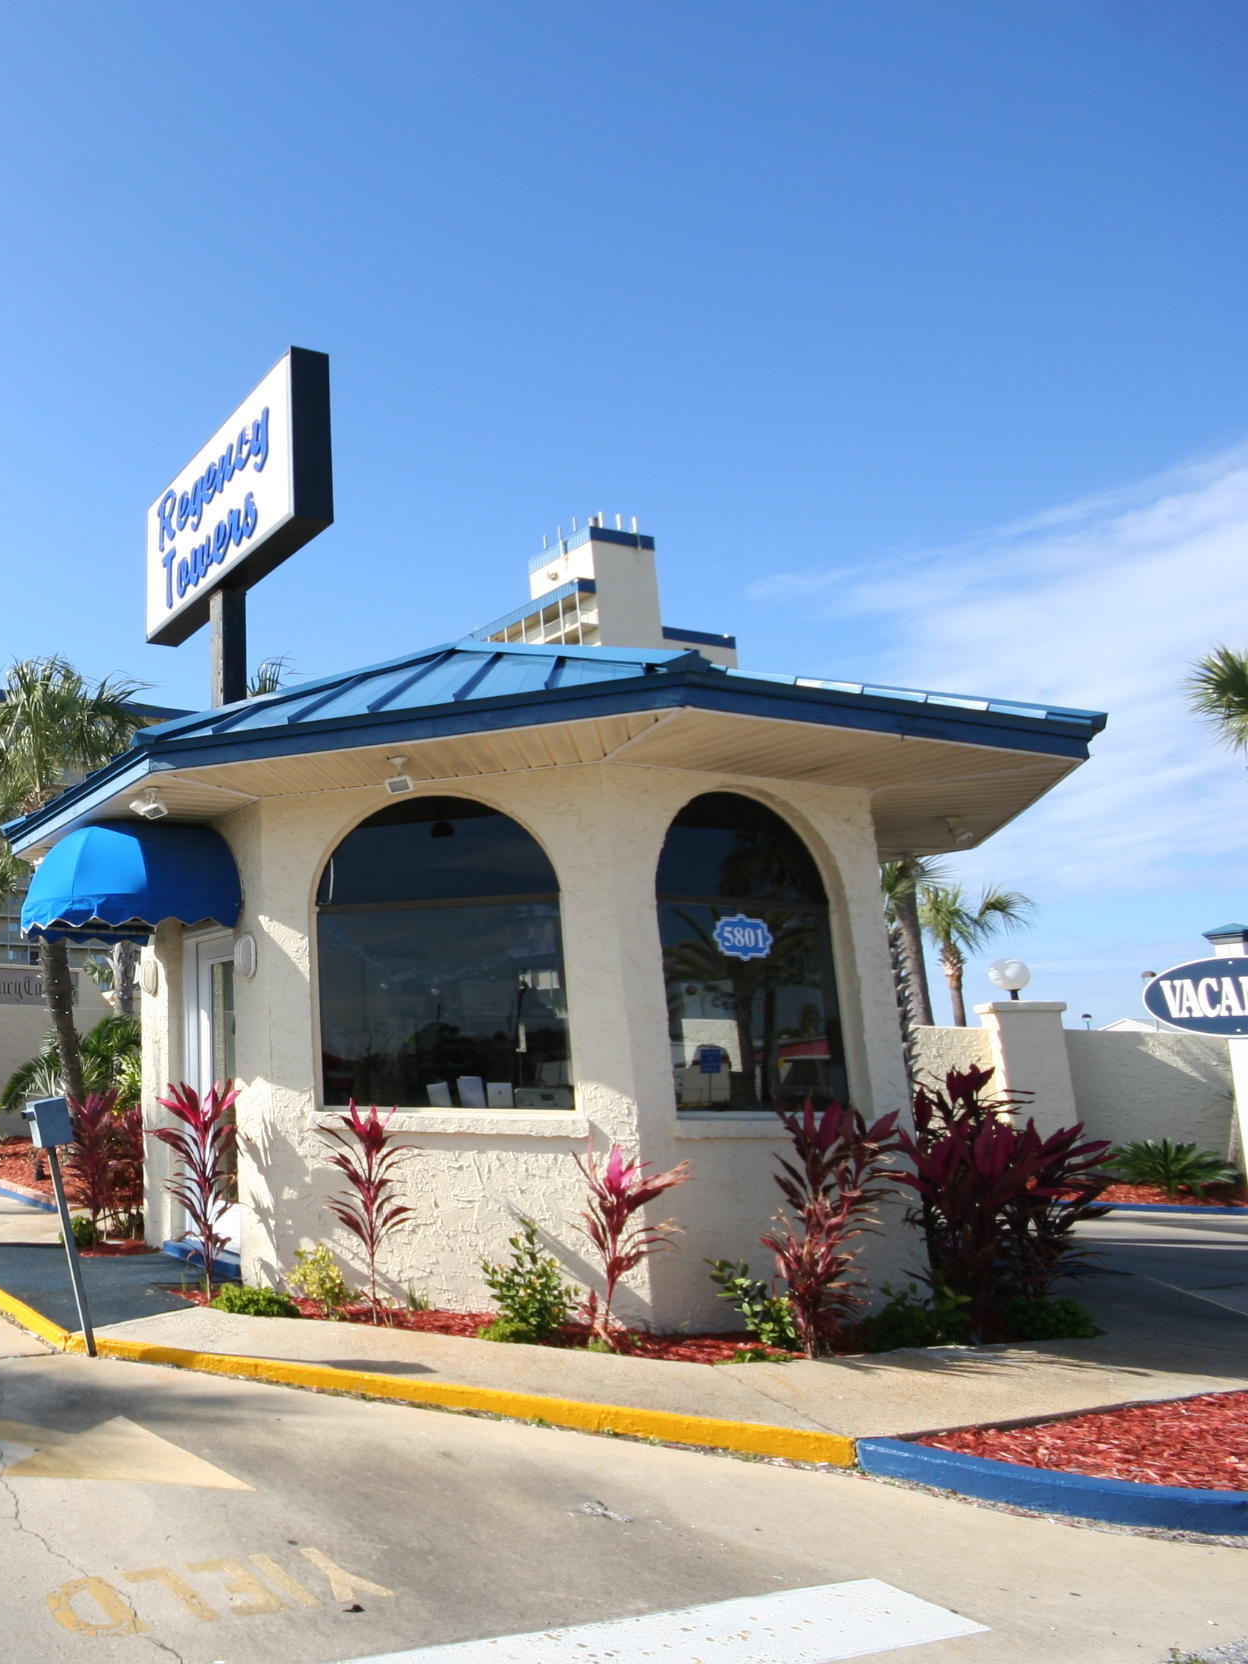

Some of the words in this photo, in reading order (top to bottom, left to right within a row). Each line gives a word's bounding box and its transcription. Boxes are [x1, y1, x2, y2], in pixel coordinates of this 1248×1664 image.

[157, 406, 270, 552] Regency
[162, 491, 258, 609] Towers
[722, 926, 765, 949] 5801
[47, 1546, 397, 1638] YIELD
